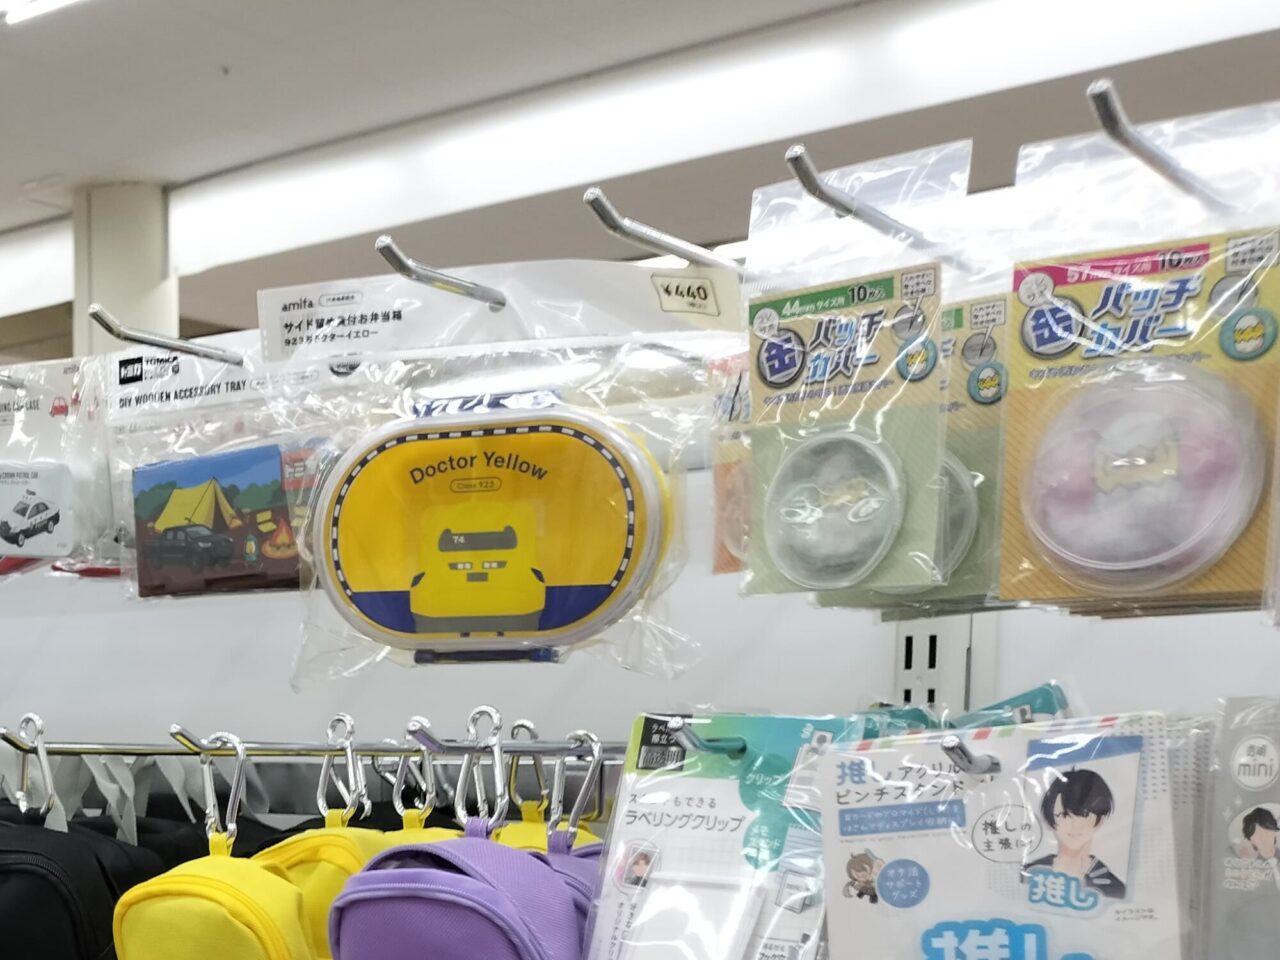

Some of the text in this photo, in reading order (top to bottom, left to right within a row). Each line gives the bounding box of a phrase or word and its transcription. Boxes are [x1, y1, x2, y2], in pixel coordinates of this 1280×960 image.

[281, 298, 314, 312] amifa
[1082, 315, 1195, 358] カバー
[766, 335, 798, 378] 缶
[805, 348, 879, 382] カバー
[224, 380, 246, 392] TRAY
[410, 451, 548, 485] Doctor Yellow
[478, 481, 495, 489] 923
[1237, 758, 1273, 777] mini
[625, 810, 745, 833] ラベリングクリップ
[1031, 872, 1095, 908] 推し
